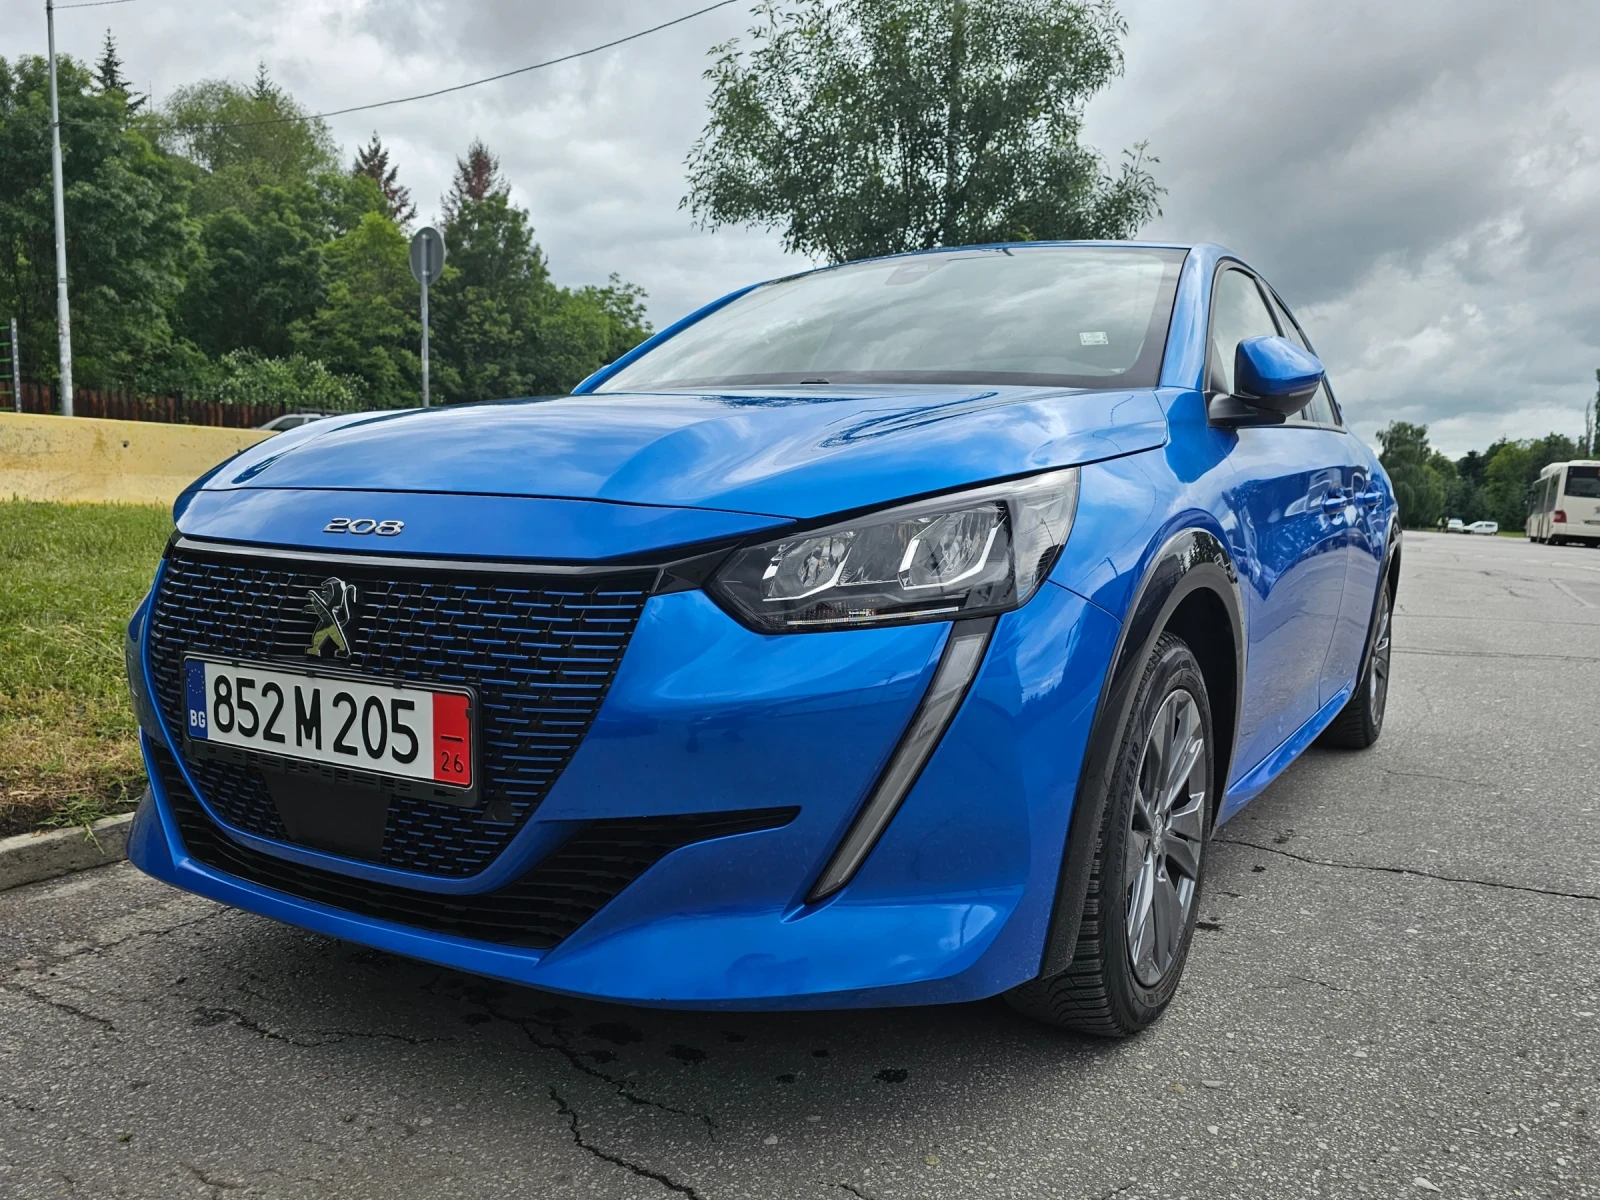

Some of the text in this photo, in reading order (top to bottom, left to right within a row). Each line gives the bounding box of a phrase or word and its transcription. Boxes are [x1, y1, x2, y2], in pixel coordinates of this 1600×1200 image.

[323, 517, 405, 536] 208
[189, 709, 206, 728] BG
[213, 674, 419, 764] 852 M 205
[441, 751, 464, 773] 26
[1115, 741, 1140, 876] GOODYEAR
